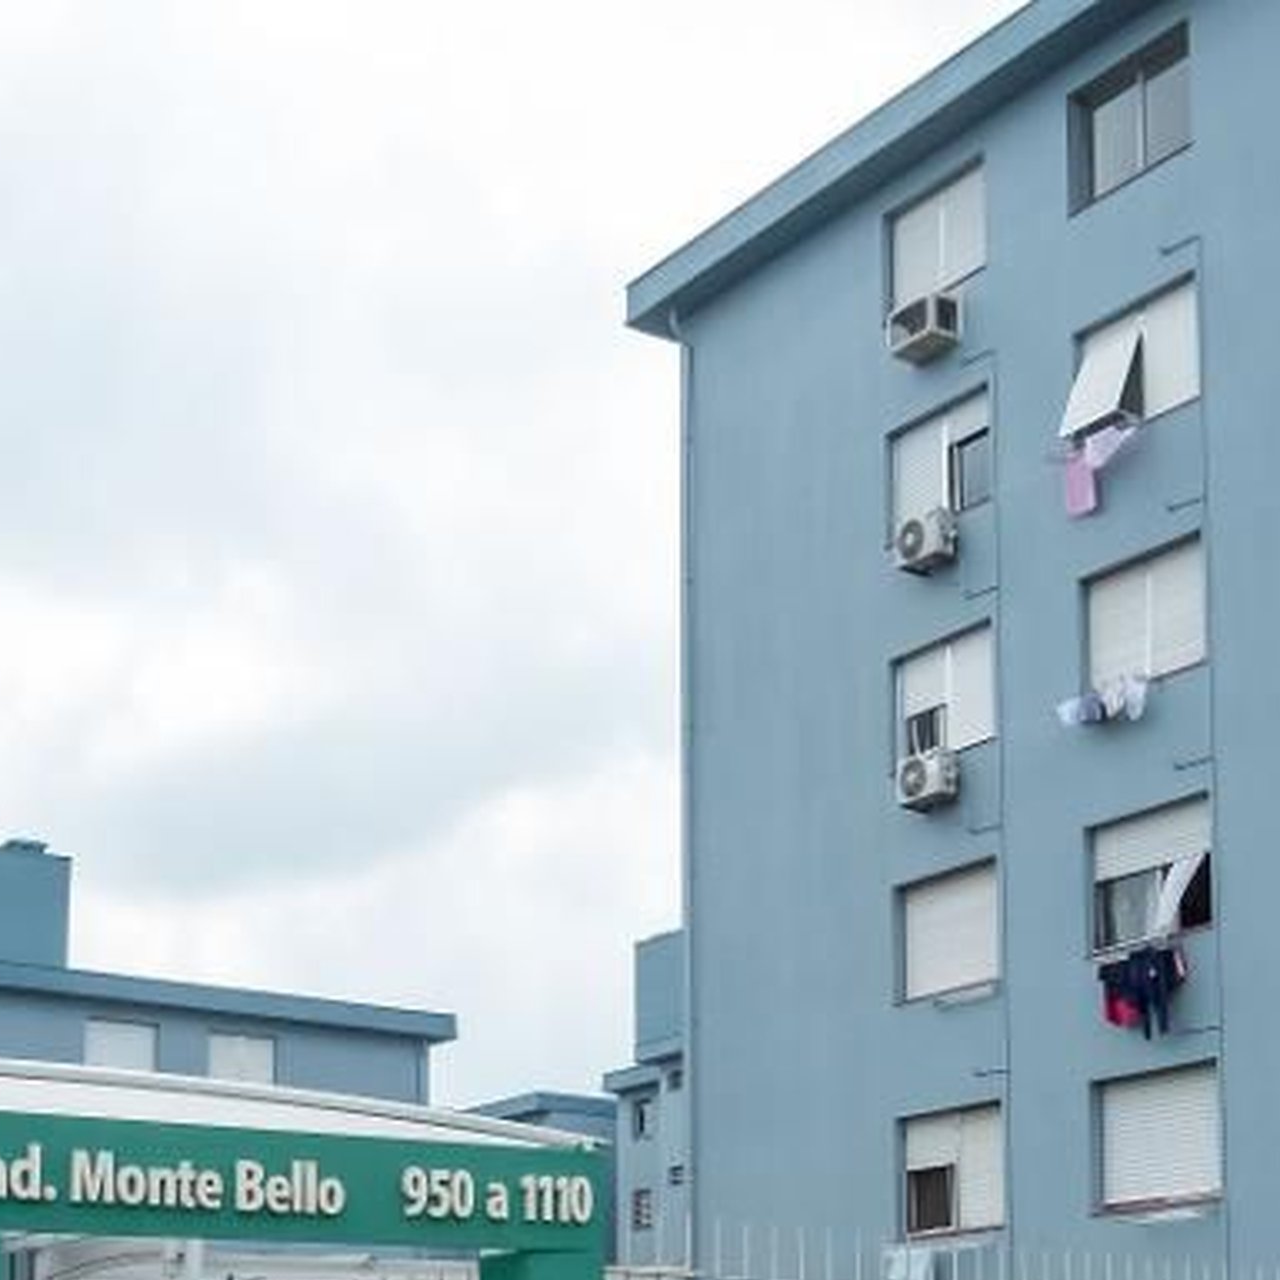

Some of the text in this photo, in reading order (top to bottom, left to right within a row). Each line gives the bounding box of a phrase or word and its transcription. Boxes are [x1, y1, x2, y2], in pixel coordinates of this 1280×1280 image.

[71, 1149, 225, 1209] Monte
[234, 1159, 346, 1215] Bello
[402, 1165, 474, 1219] 950
[486, 1181, 509, 1220] a
[521, 1173, 594, 1224] 1110
